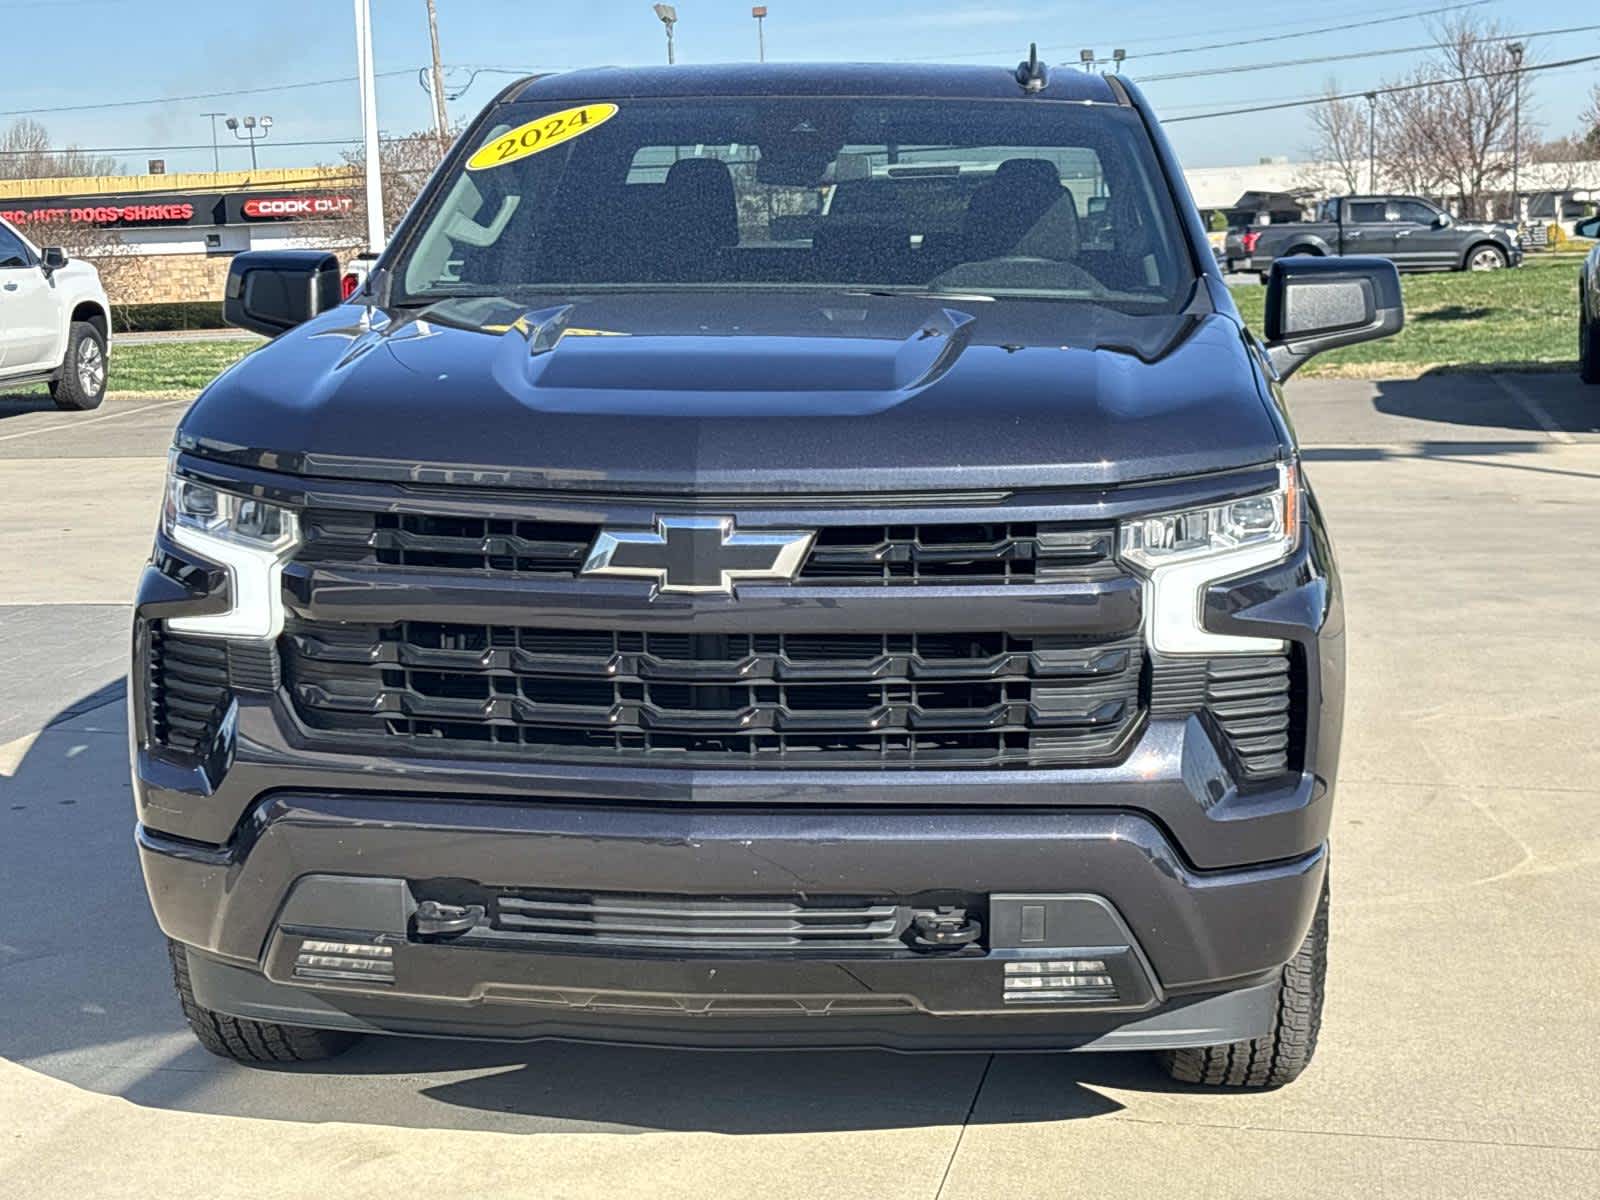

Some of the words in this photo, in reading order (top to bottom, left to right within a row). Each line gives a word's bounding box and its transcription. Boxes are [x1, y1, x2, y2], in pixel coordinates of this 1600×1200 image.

[496, 109, 593, 160] 2024
[259, 200, 312, 213] COOK
[315, 198, 353, 211] OUT
